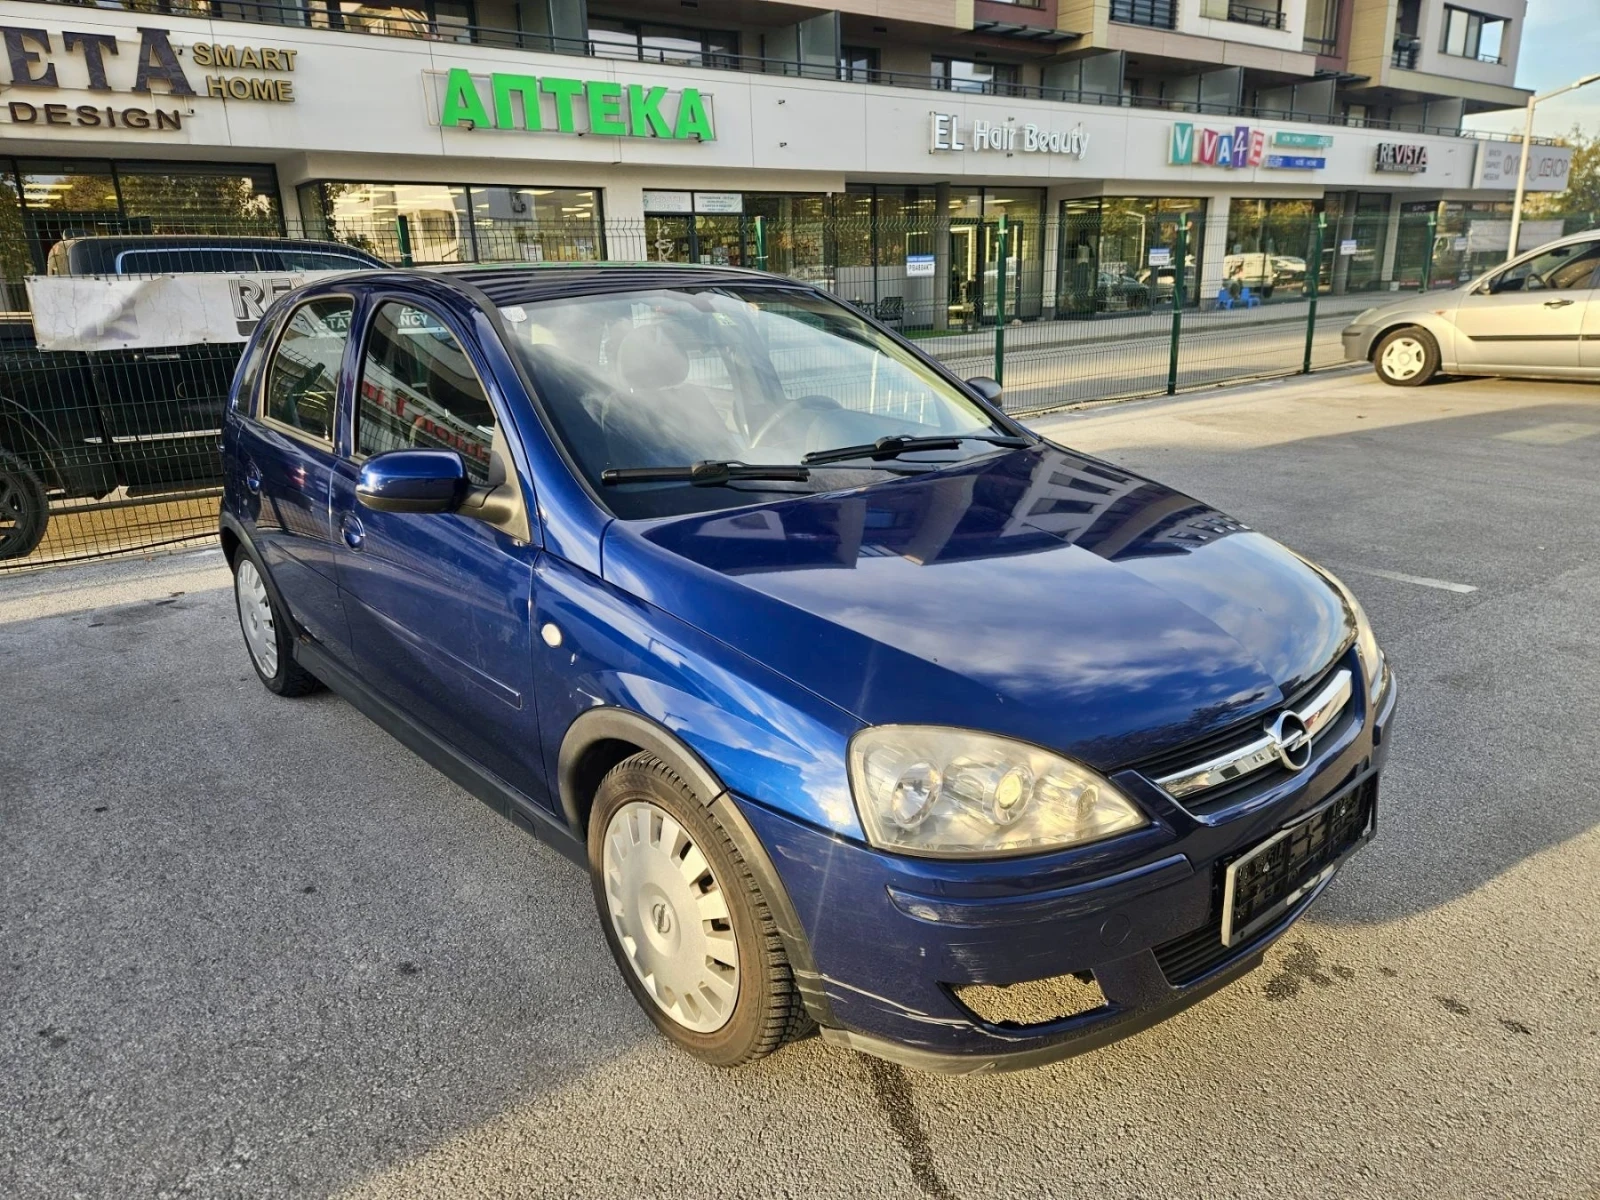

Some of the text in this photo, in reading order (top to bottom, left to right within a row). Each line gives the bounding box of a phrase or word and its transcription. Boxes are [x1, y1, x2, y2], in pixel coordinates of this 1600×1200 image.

[193, 42, 297, 71] SMART
[206, 75, 295, 102] HOME
[8, 101, 182, 130] DESIGN
[441, 68, 713, 141] АПТЕКА
[933, 113, 1090, 160] EL Hair Beauty
[1379, 143, 1428, 165] REVISTA
[1503, 154, 1532, 177] ФЛР
[228, 277, 305, 320] RE
